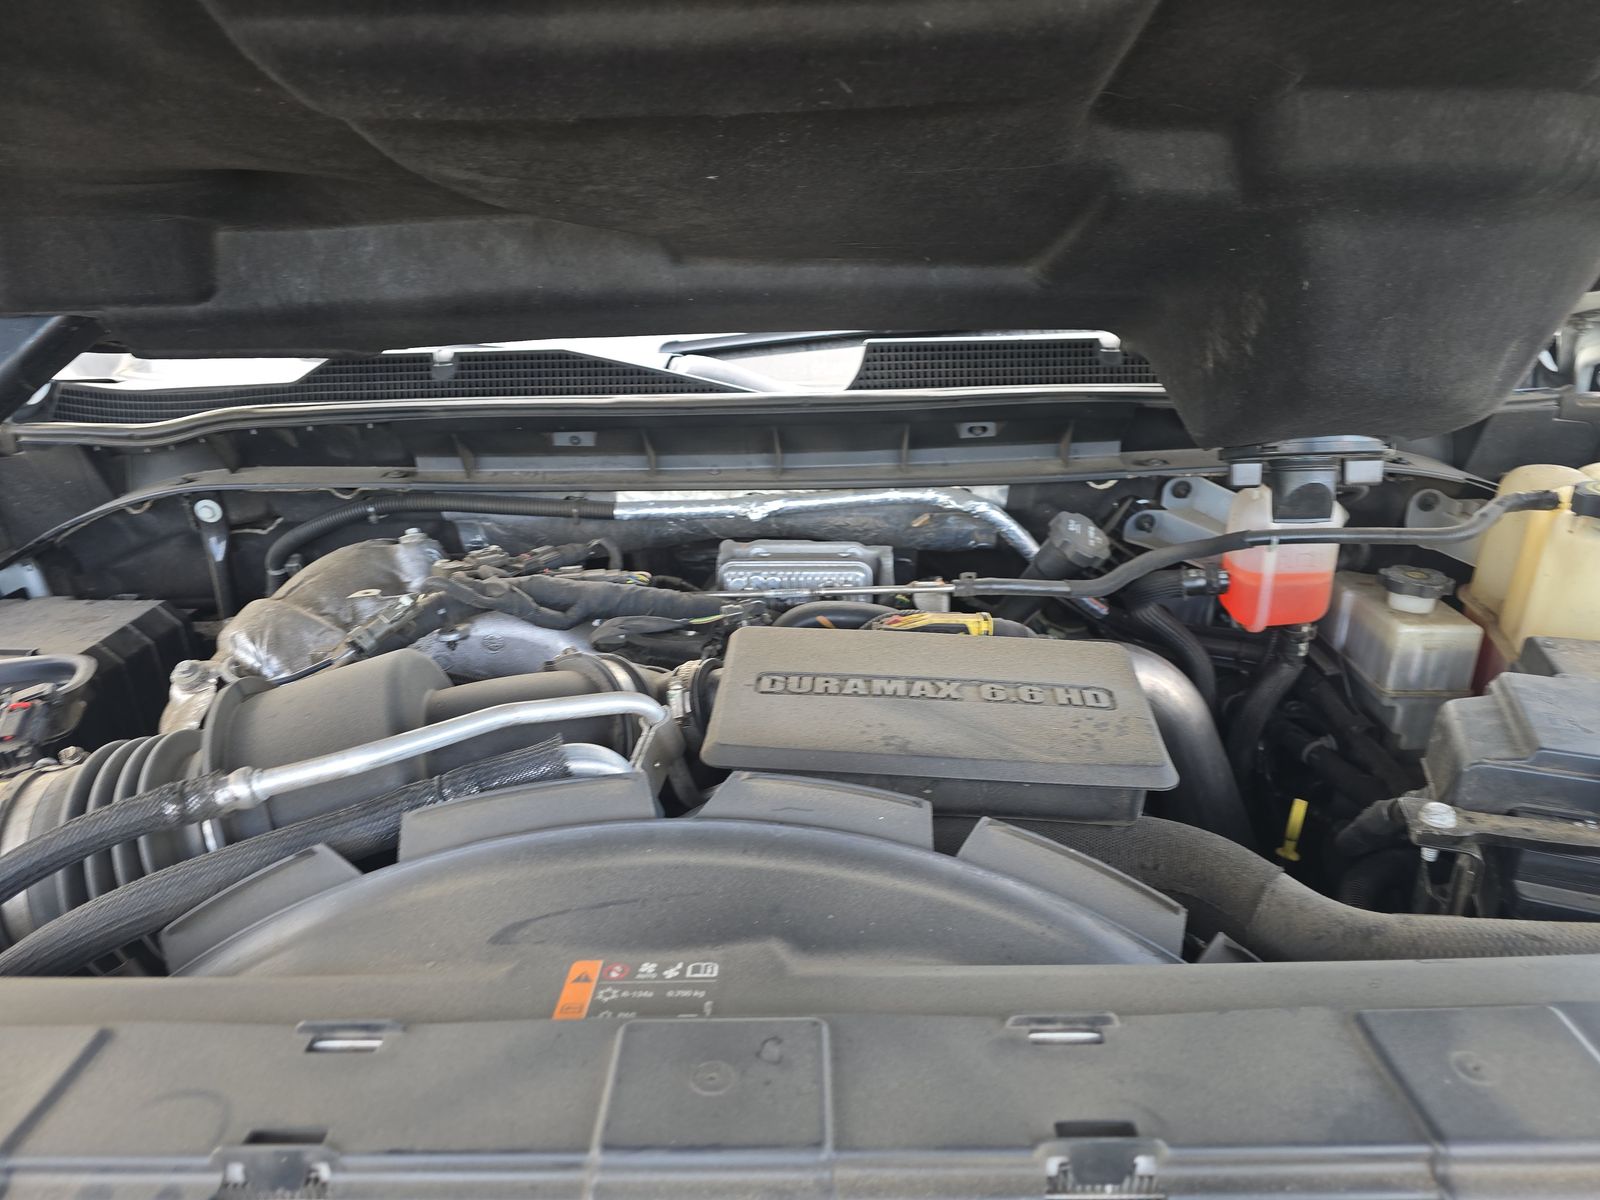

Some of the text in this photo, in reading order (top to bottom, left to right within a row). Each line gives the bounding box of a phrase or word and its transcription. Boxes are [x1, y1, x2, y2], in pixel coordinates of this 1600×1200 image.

[758, 675, 1114, 709] DURAMAX 6.6 HD
